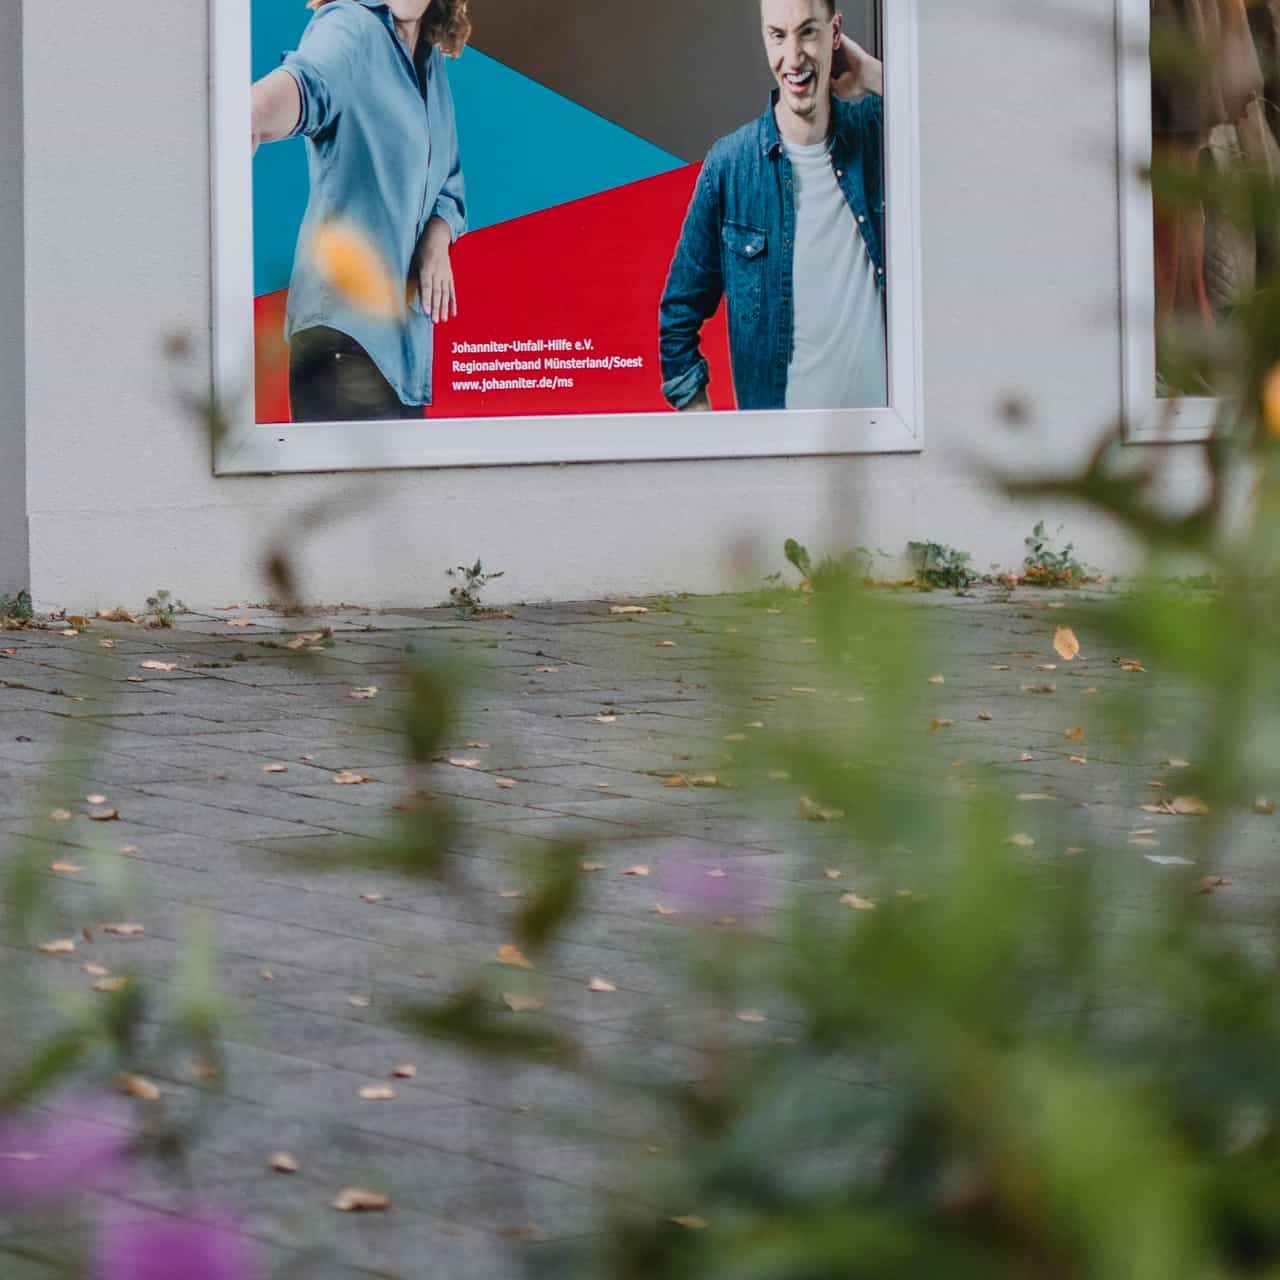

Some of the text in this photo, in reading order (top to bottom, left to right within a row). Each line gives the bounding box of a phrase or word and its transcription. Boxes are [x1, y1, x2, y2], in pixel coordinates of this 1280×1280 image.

[451, 338, 594, 353] Johanniter-Unfall-Hilfe e.V.
[452, 356, 643, 374] Regionalverband Münsterland/Soest
[452, 376, 573, 392] www.johanniter.de/ms
